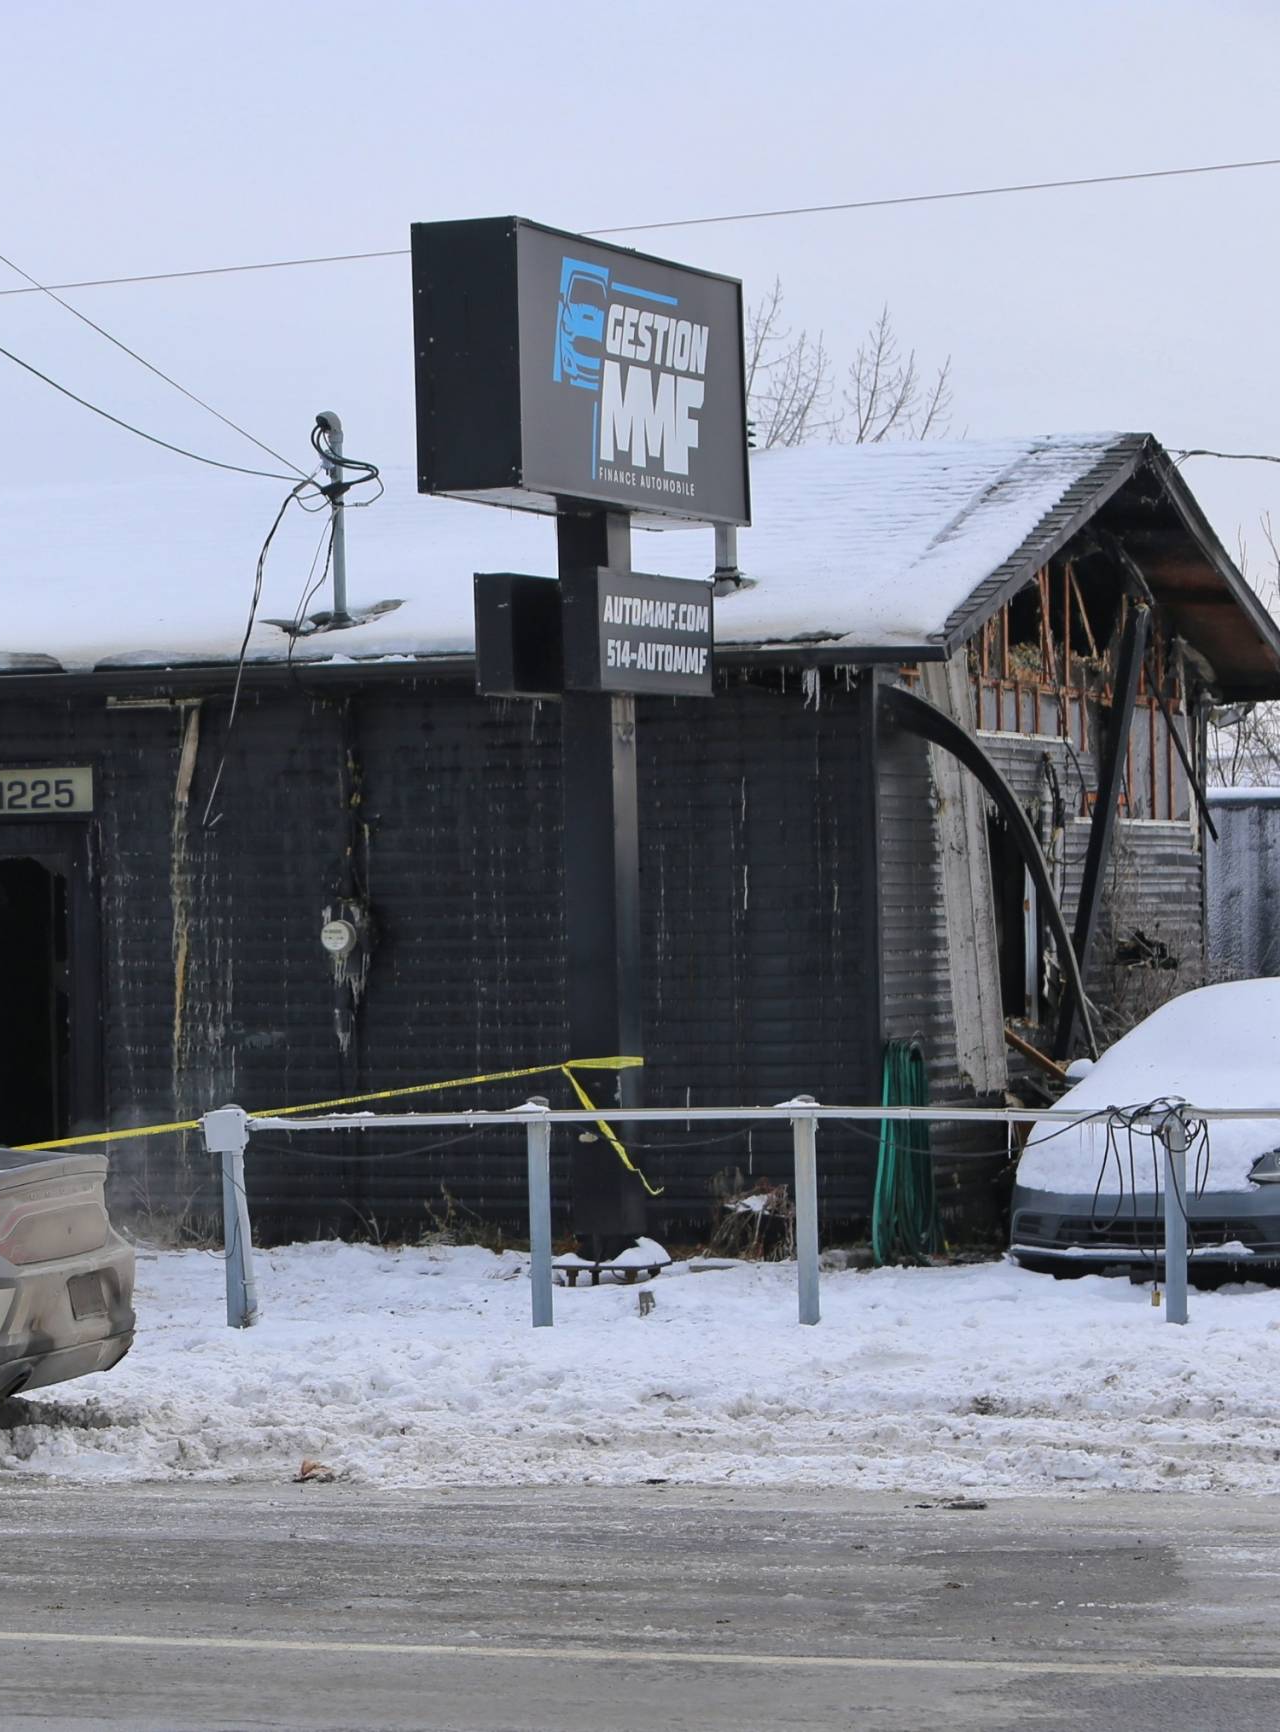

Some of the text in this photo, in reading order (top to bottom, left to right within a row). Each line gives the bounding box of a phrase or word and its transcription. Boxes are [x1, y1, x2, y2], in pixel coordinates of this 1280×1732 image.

[606, 303, 709, 375] GESTION
[600, 359, 705, 475] MMF
[599, 467, 696, 497] FINANCE AUTOMOBILE
[603, 595, 709, 633] AUTOMMF.COM
[607, 639, 708, 675] 514-AUTOMMF
